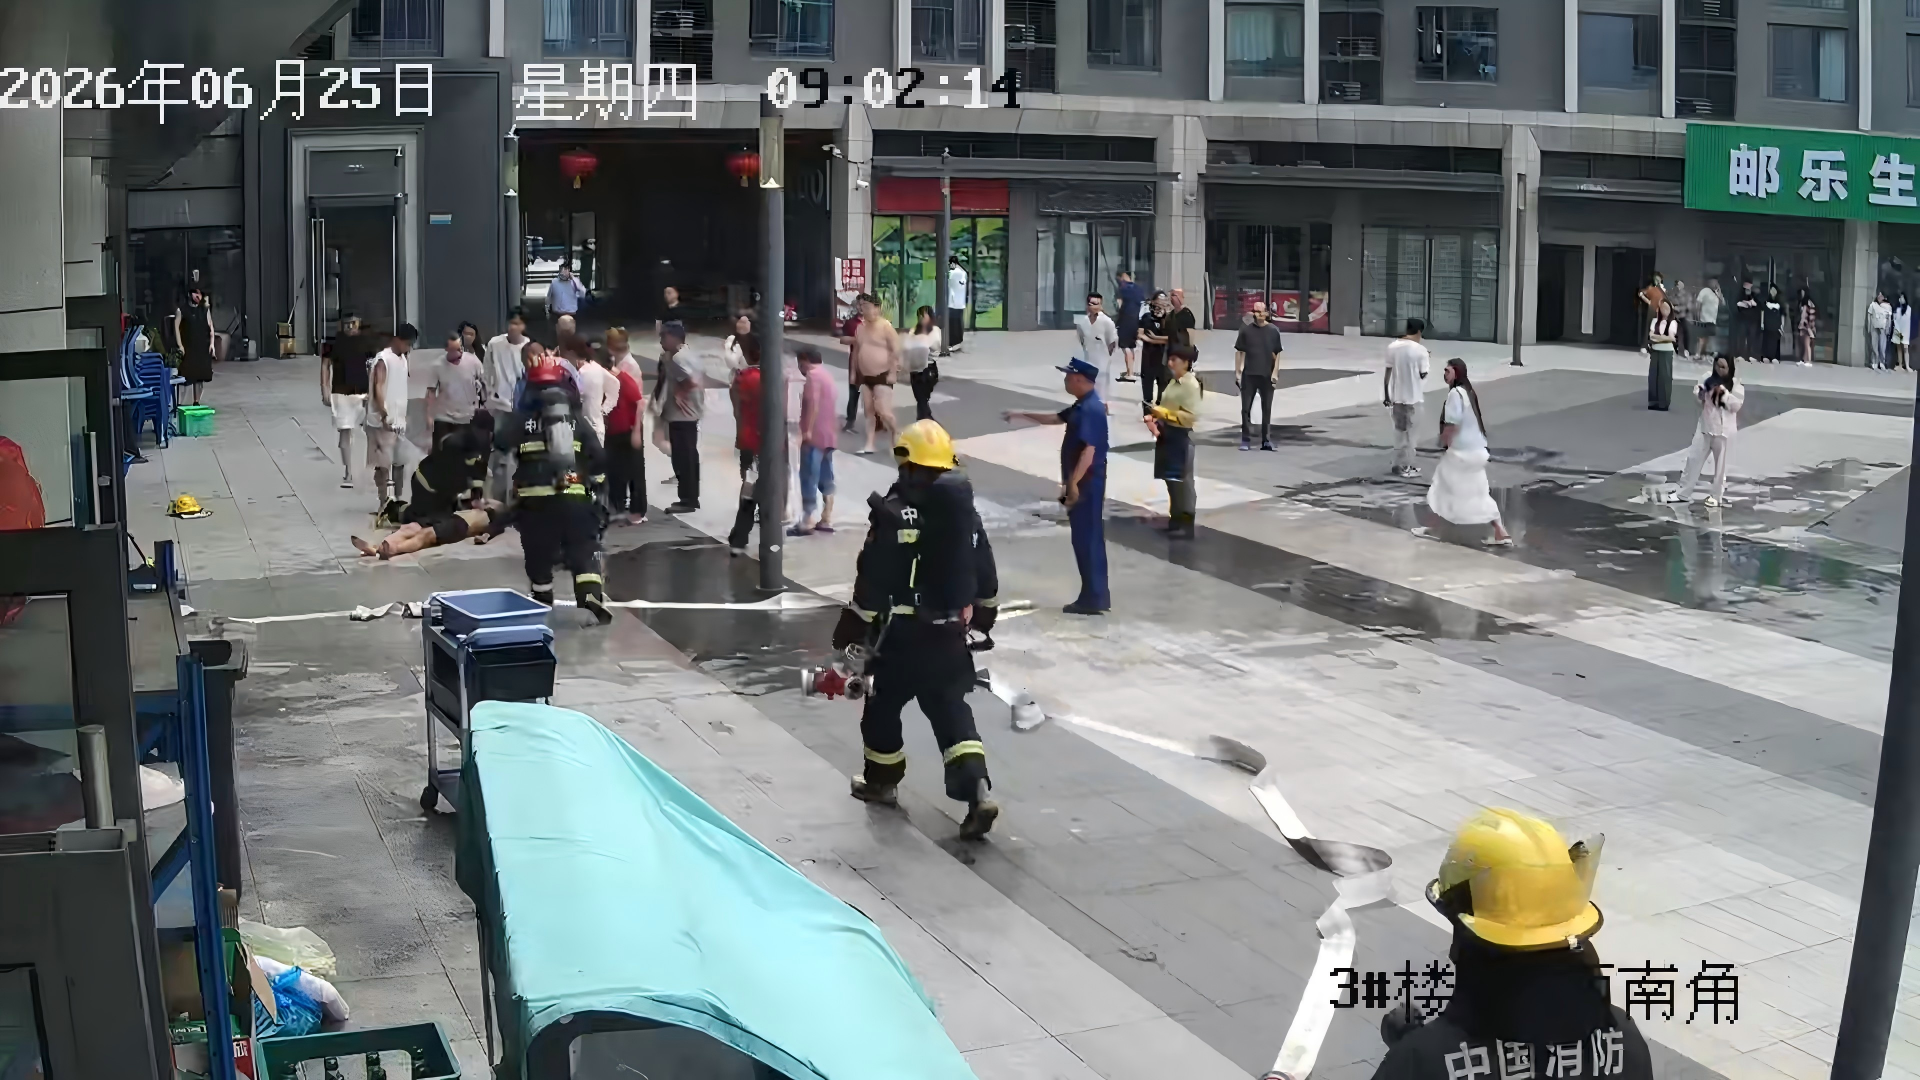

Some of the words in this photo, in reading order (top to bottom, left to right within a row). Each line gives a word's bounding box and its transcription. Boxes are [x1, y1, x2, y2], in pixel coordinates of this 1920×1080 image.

[1729, 143, 1917, 207] 邮乐生
[1444, 1026, 1626, 1080] 中国消防
